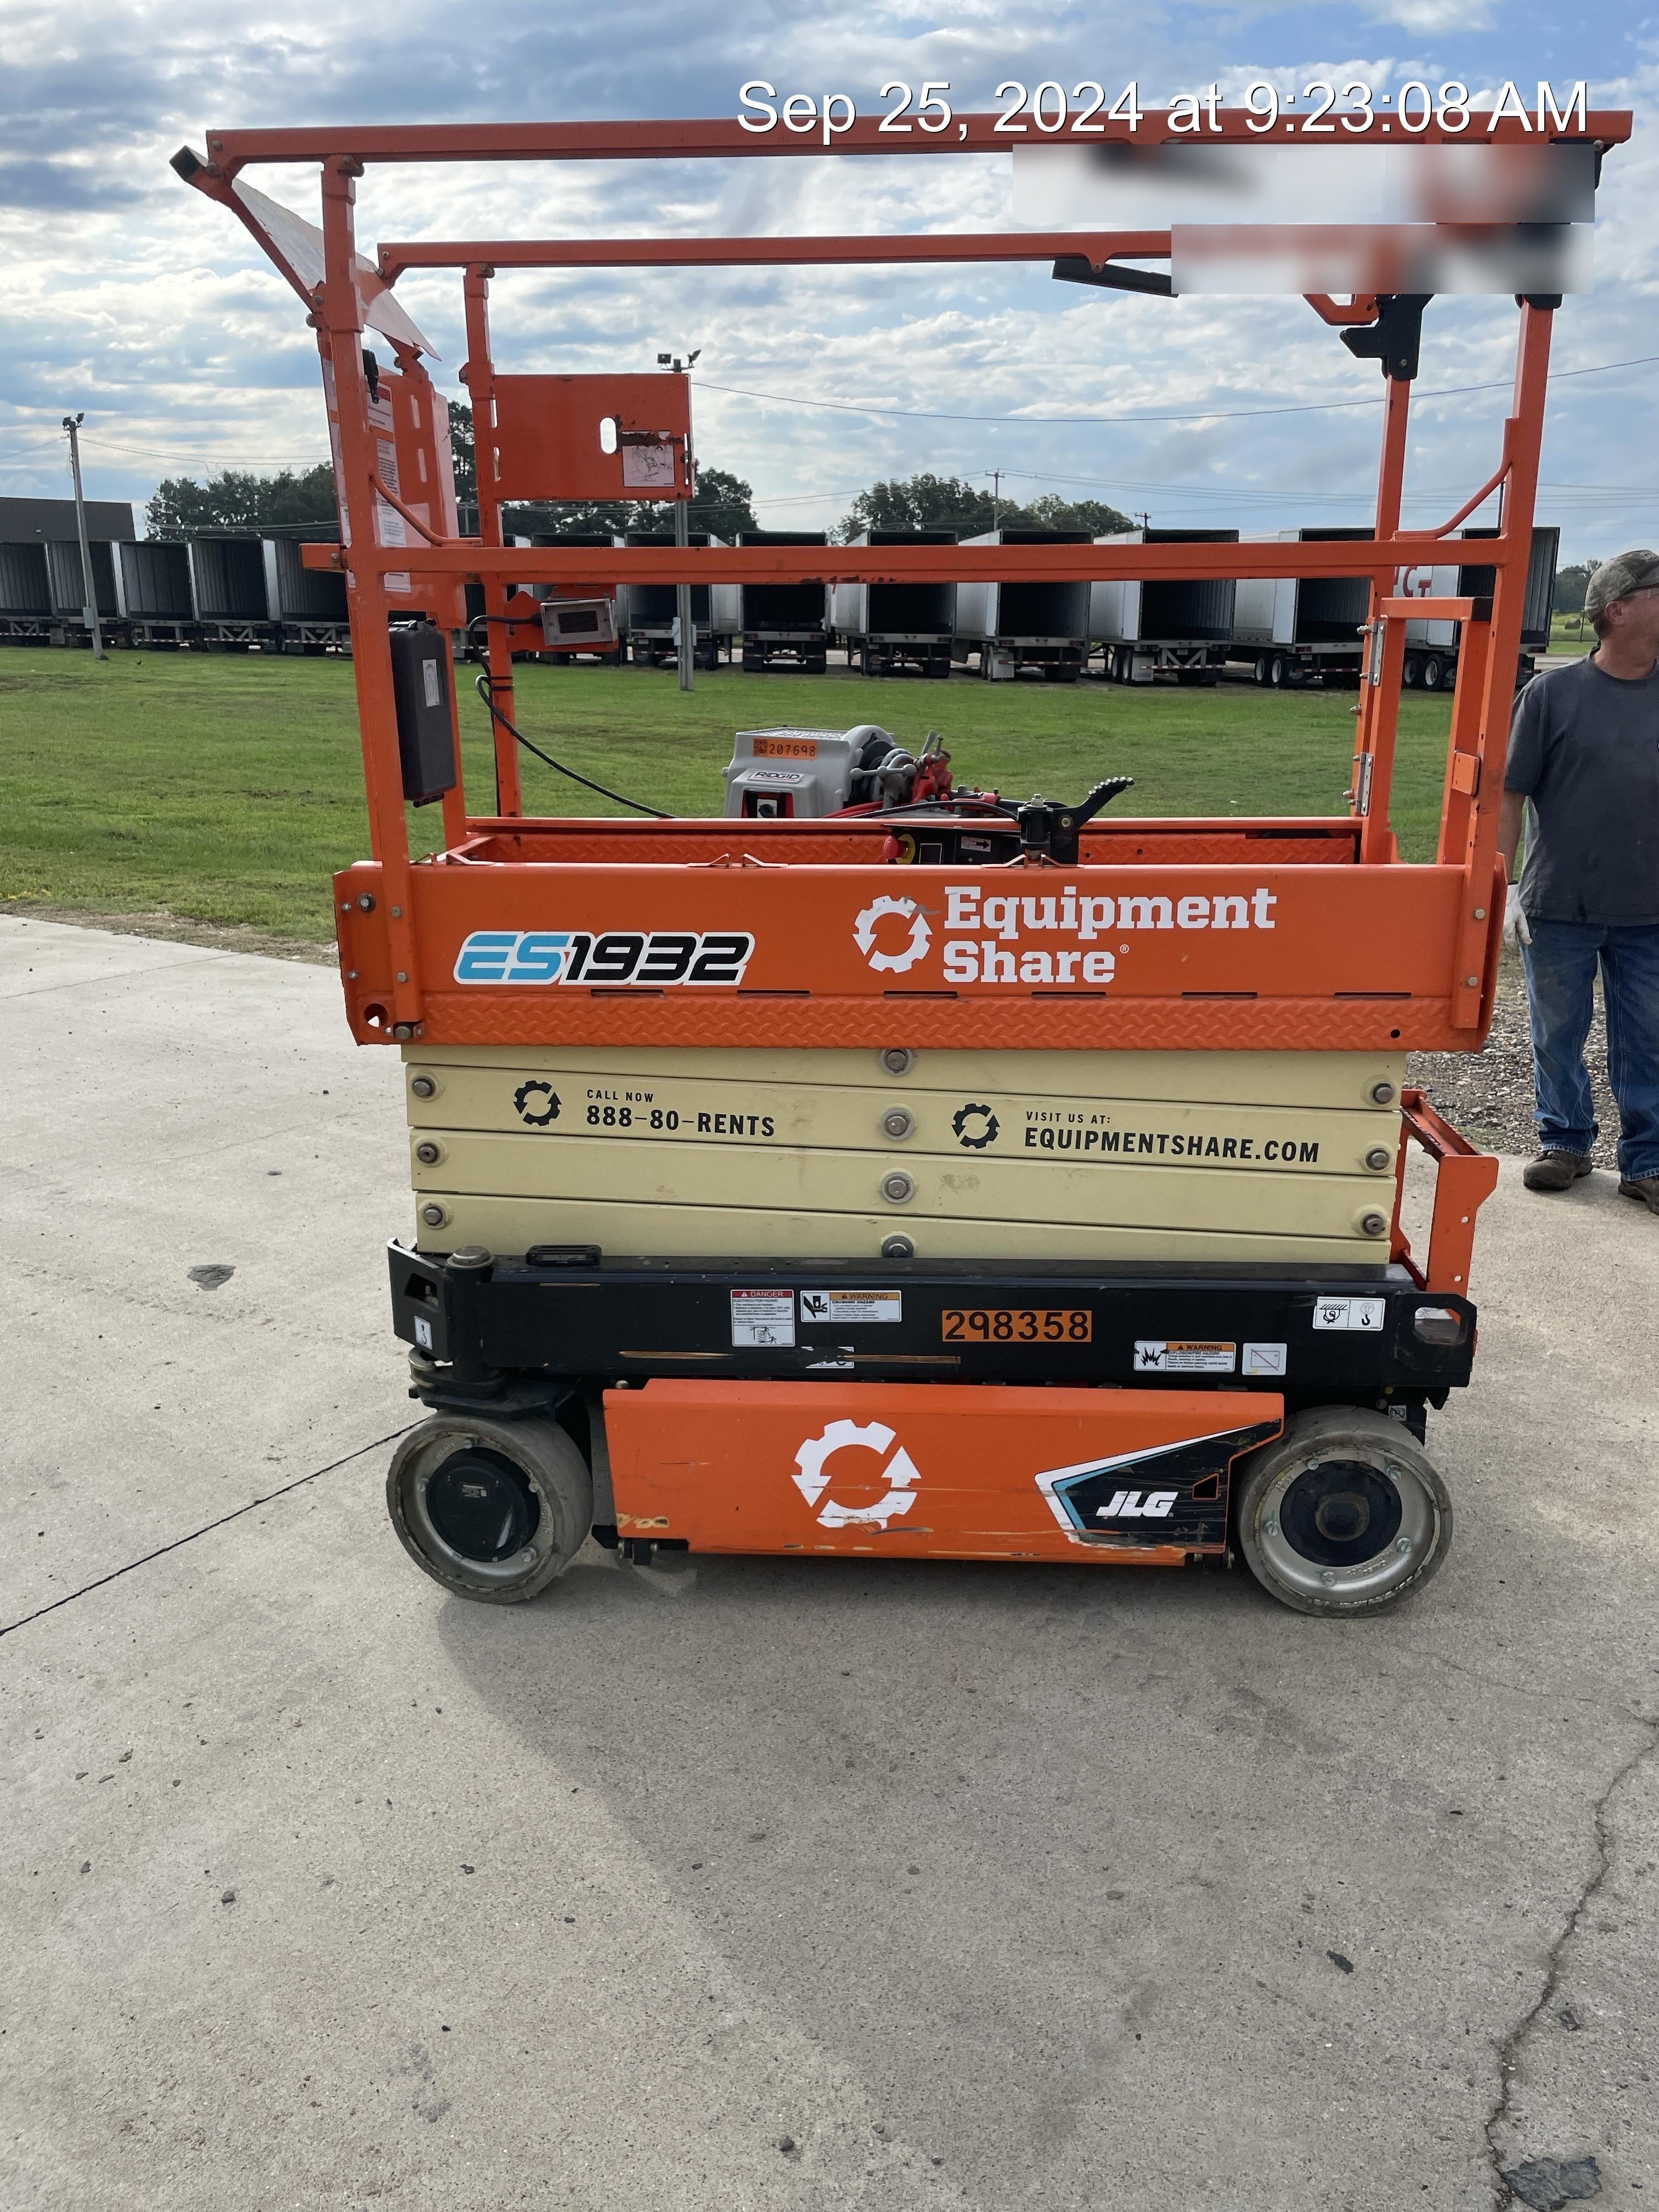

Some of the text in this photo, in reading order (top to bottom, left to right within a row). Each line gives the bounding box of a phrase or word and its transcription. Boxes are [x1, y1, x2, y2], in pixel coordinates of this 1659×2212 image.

[944, 885, 1278, 939] Equipment
[456, 934, 751, 981] ES1932
[586, 1089, 654, 1103] CALL NOW
[586, 1105, 775, 1137] 888-80-RENTS
[1025, 1111, 1111, 1125] VISIT US AT:
[1024, 1126, 1319, 1163] EQUIPMENTSHARE.COM
[945, 1311, 1088, 1340] 298358
[1096, 1491, 1179, 1517] JLG
